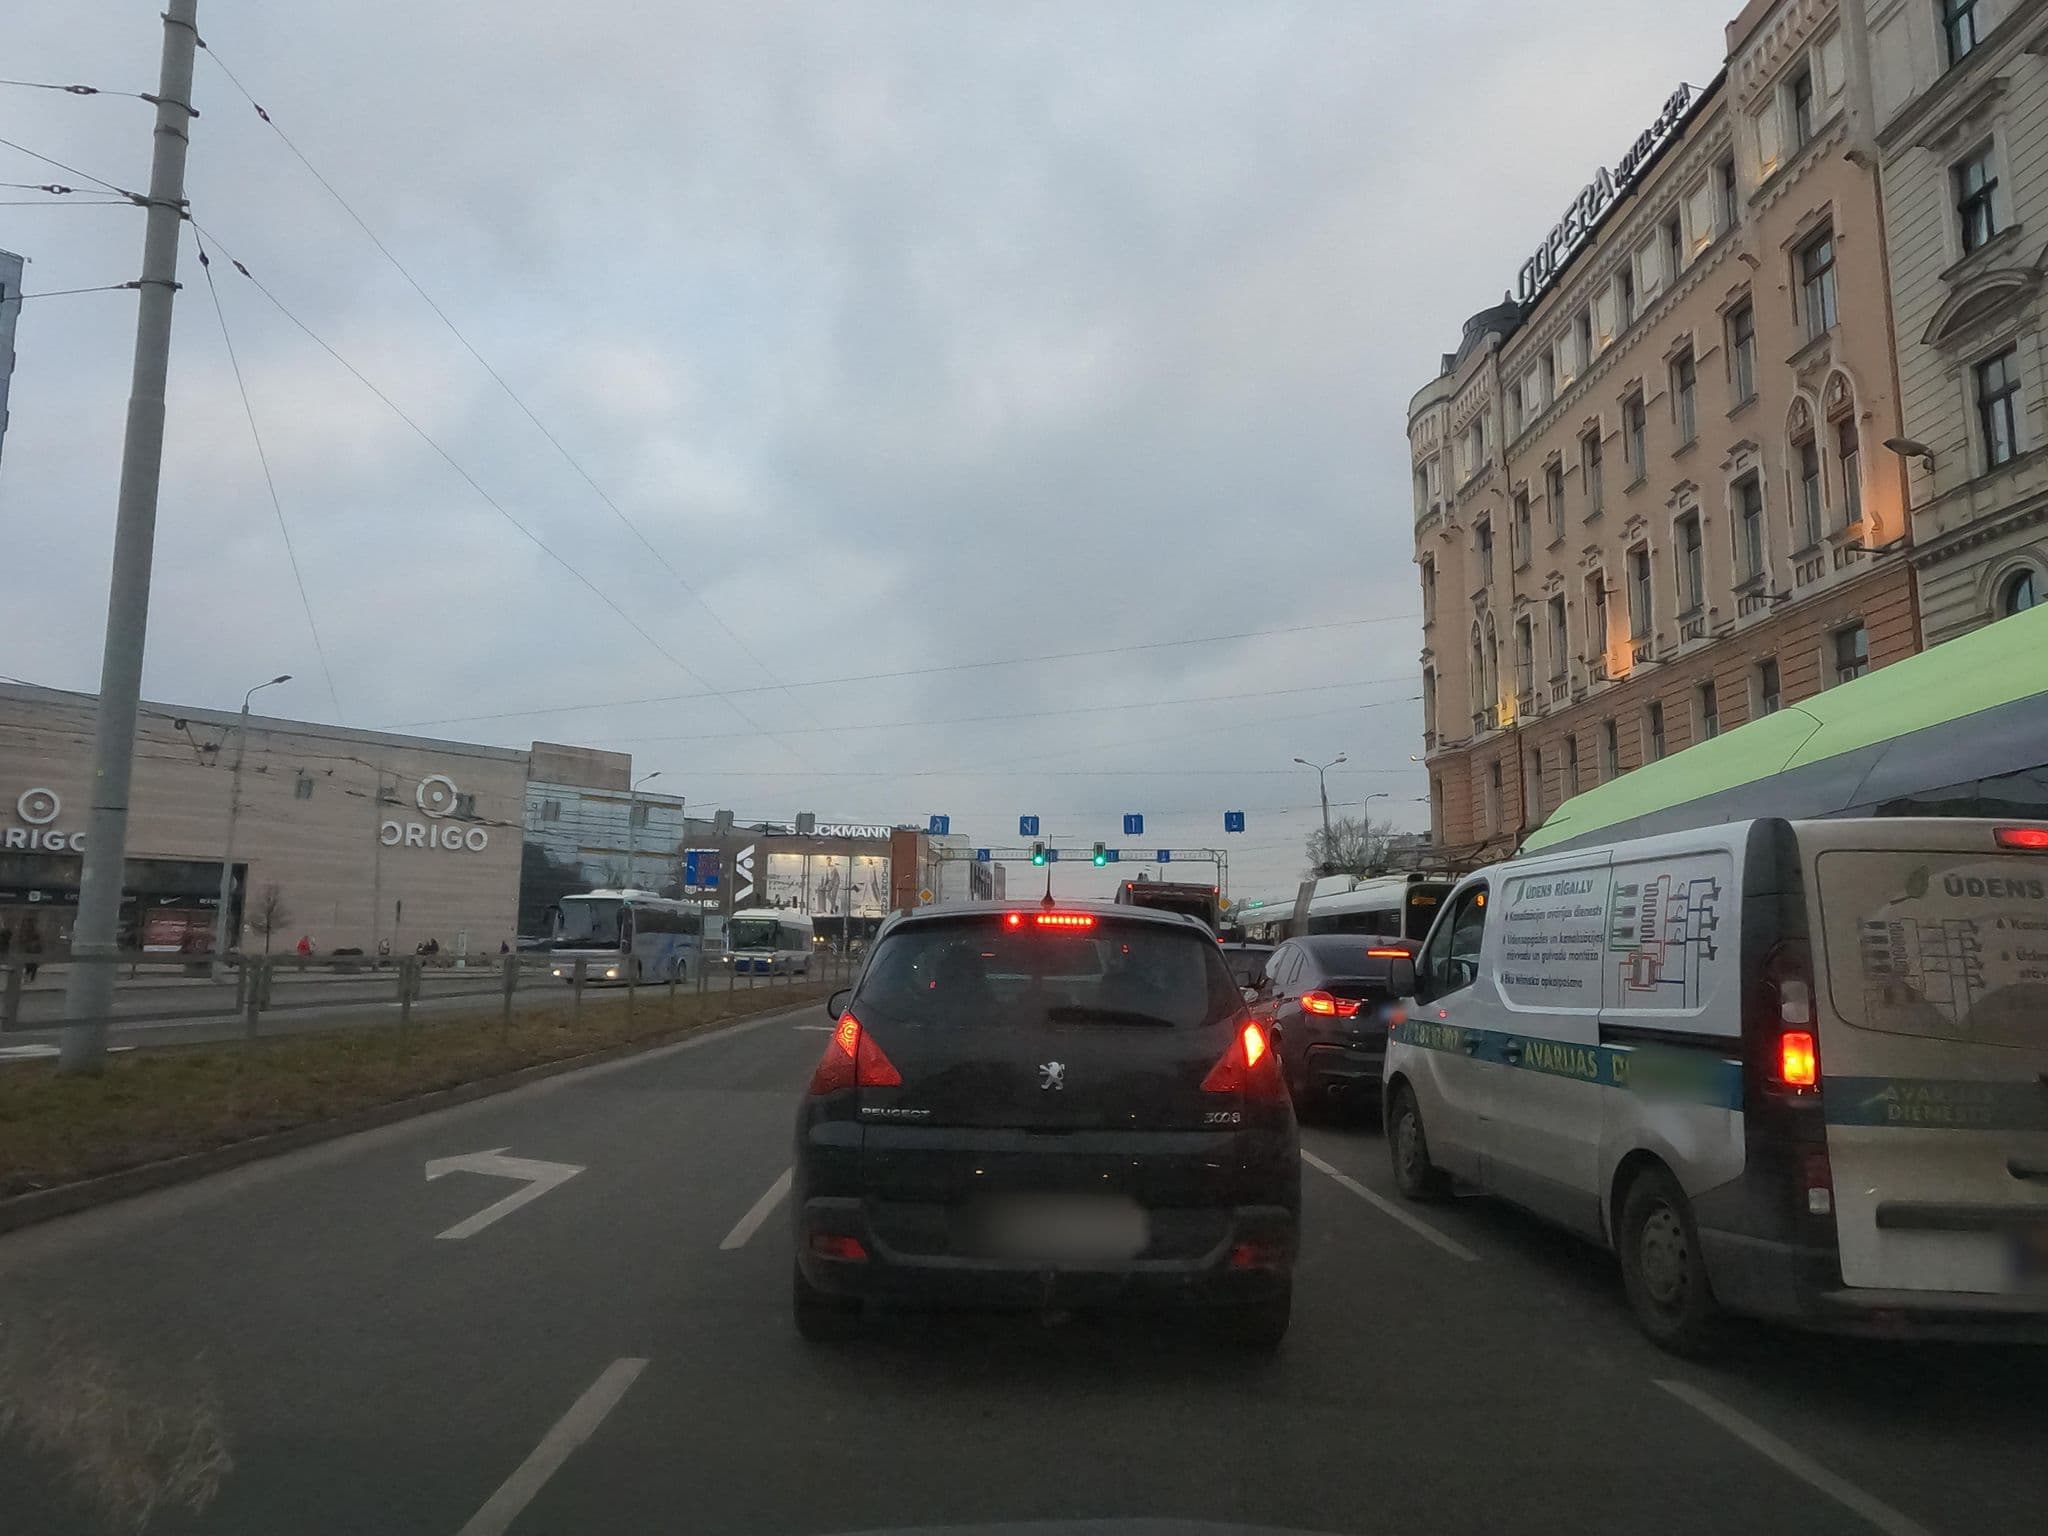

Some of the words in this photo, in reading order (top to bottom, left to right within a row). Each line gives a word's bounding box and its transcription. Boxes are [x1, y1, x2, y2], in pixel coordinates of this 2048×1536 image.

[0, 828, 88, 852] RIGO
[381, 821, 488, 851] ORIGO
[785, 825, 891, 839] SCKMANN
[1944, 873, 2044, 899] ŪDENS
[1477, 895, 1485, 906] 9
[861, 1107, 931, 1119] PEUGEOT
